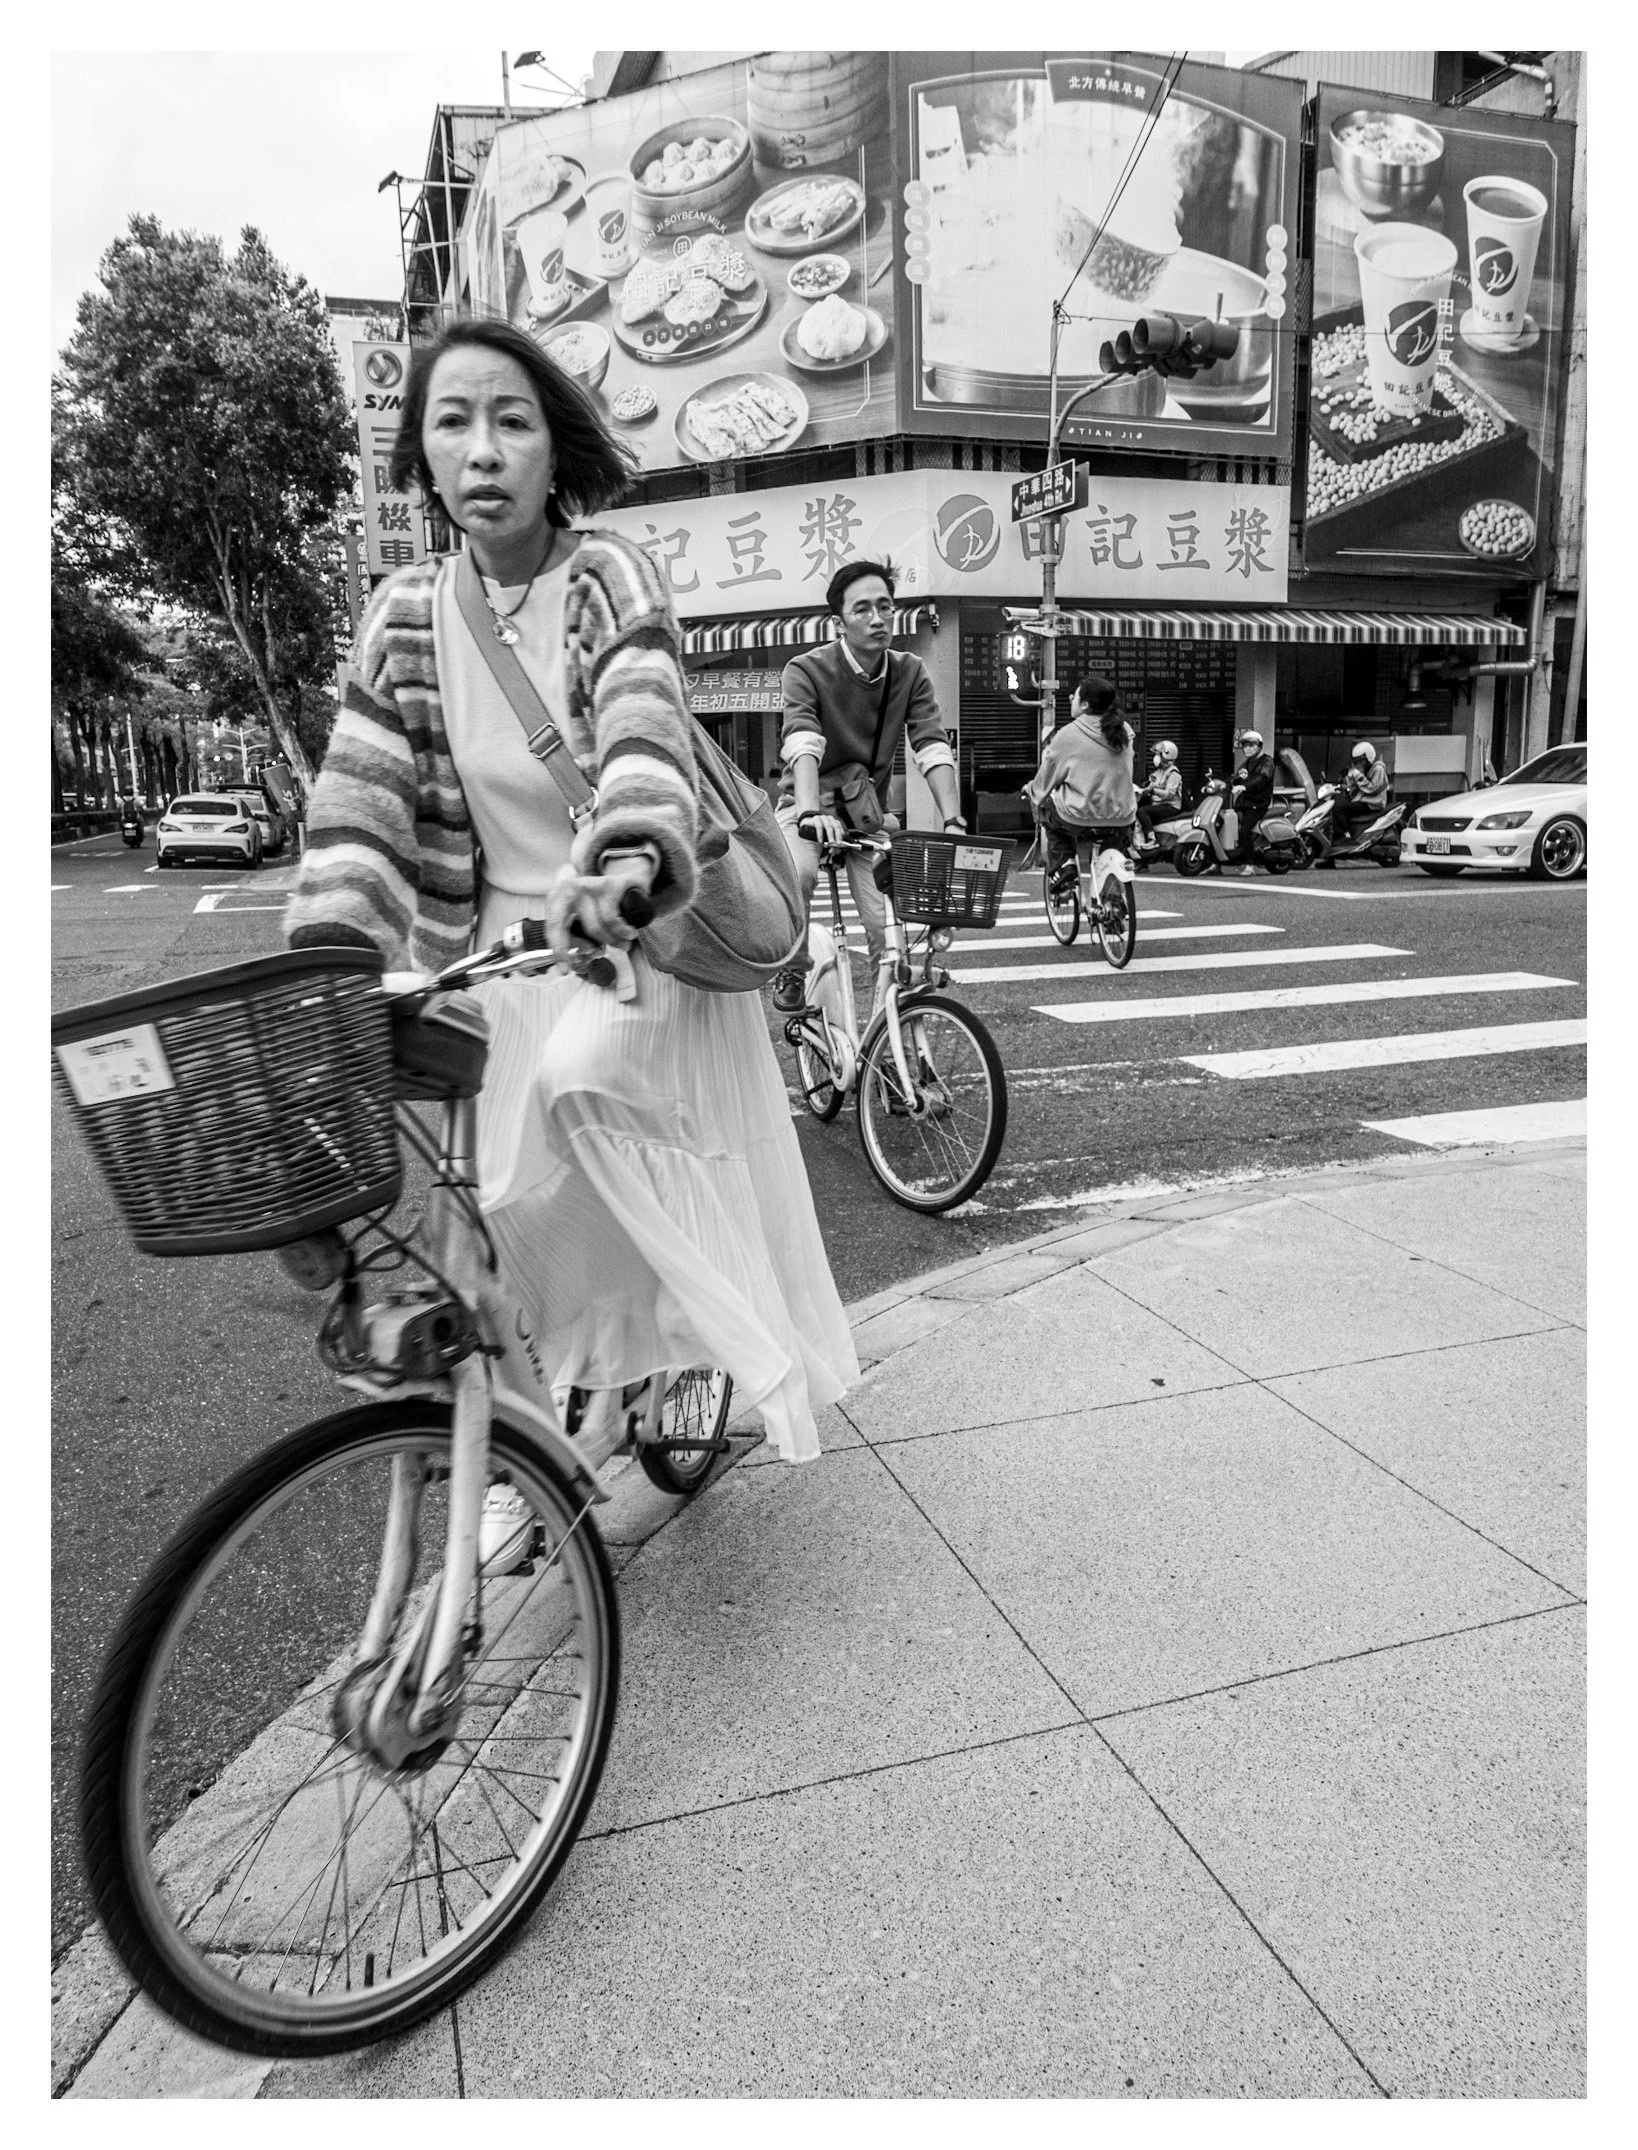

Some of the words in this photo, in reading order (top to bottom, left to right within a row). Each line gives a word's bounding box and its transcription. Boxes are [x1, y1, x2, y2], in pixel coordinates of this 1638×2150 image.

[1068, 75, 1146, 100] 北方傳統早餐
[664, 211, 707, 226] SOYBEAN
[707, 215, 728, 234] MILK
[1079, 427, 1112, 438] TIAN
[1121, 431, 1133, 439] JI
[1019, 467, 1065, 500] 中華四路
[1007, 635, 1025, 660] 18
